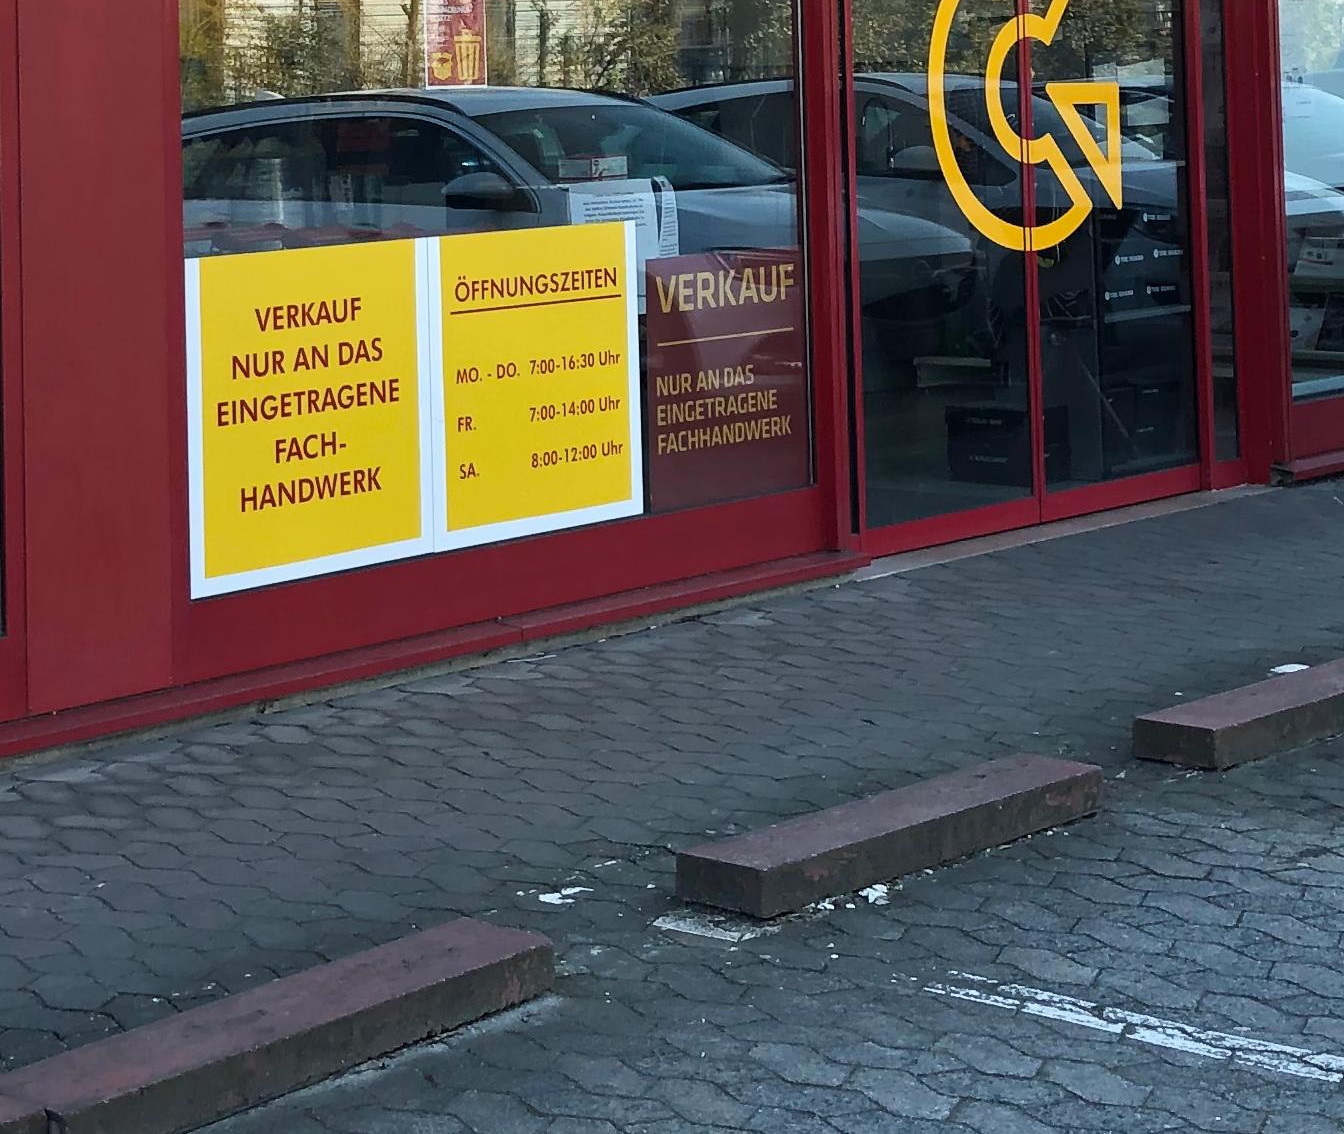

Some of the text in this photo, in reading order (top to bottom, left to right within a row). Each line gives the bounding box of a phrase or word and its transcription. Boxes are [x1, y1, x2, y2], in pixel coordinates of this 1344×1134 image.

[455, 267, 618, 302] ÖFFNUNGSZEITEN
[656, 263, 794, 313] VERKAUF
[255, 297, 362, 332] VERKAUF
[232, 338, 383, 380] NUR AN DAS
[456, 367, 483, 385] MO.
[497, 362, 521, 380] DO.
[529, 352, 595, 375] 7:00-16:30
[599, 350, 621, 366] Uhr
[657, 365, 754, 397] NUR AN DAS
[217, 378, 400, 427] EINGETRAGENE
[457, 395, 621, 433] FR. 7:00-14:00 Uhr
[657, 389, 777, 427] EINGETRAGENE
[275, 431, 347, 464] FACH-
[658, 415, 792, 455] FACHHANDWERK
[459, 440, 624, 480] SA. 8:00-12:00 Uhr
[240, 466, 382, 513] HANDWERK
